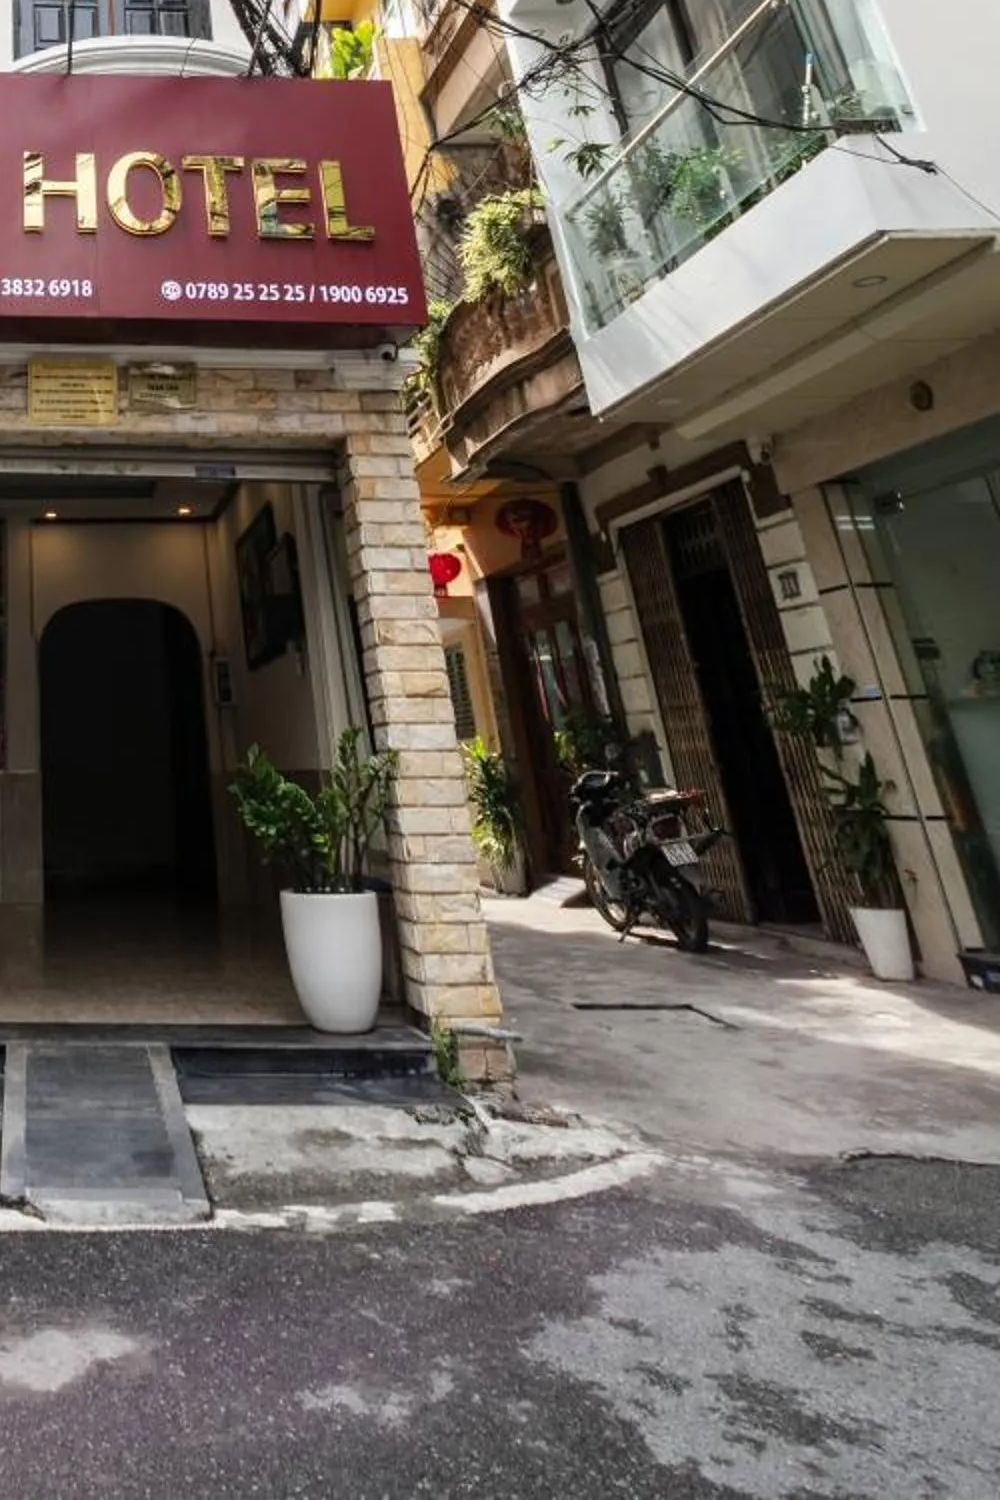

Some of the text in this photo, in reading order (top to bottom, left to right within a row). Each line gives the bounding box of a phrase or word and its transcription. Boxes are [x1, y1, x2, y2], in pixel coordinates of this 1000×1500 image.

[22, 150, 376, 242] HOTEL
[1, 278, 45, 296] 3832
[49, 279, 93, 297] 6918
[185, 282, 229, 300] 0789
[233, 283, 254, 301] 25
[259, 283, 280, 301] 25
[284, 284, 305, 301] 25
[320, 285, 362, 303] 1900
[365, 286, 409, 304] 6925
